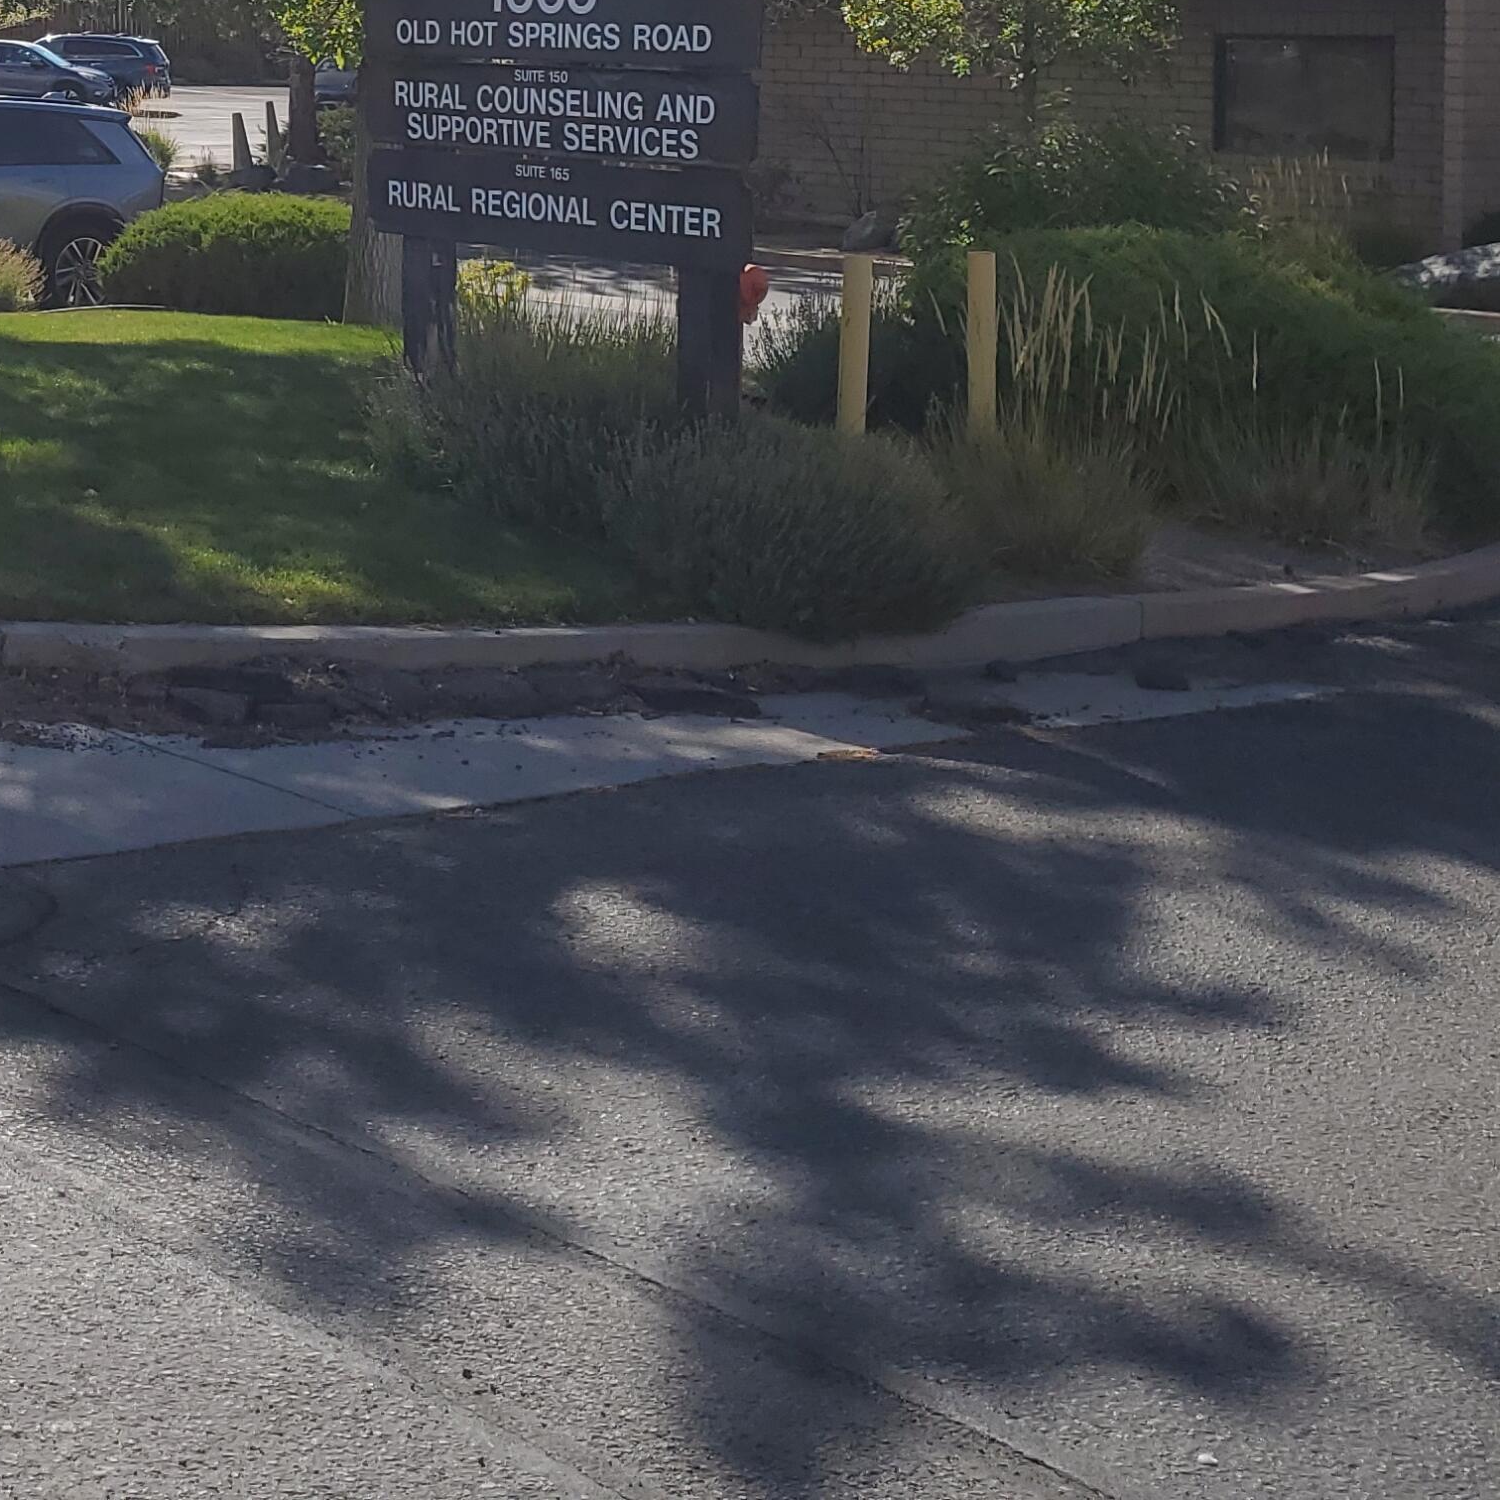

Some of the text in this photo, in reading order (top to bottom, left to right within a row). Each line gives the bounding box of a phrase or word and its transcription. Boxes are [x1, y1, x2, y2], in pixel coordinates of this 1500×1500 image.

[396, 19, 712, 52] OLD HOT SPRINGS ROAD
[514, 69, 568, 84] SUITE 150
[394, 81, 715, 125] RURAL COUNSELING AND
[406, 112, 699, 160] SUPPORTIVE SERVICES
[515, 164, 570, 181] SUITE 165
[388, 180, 722, 238] RURAL REGIONAL CENTER
